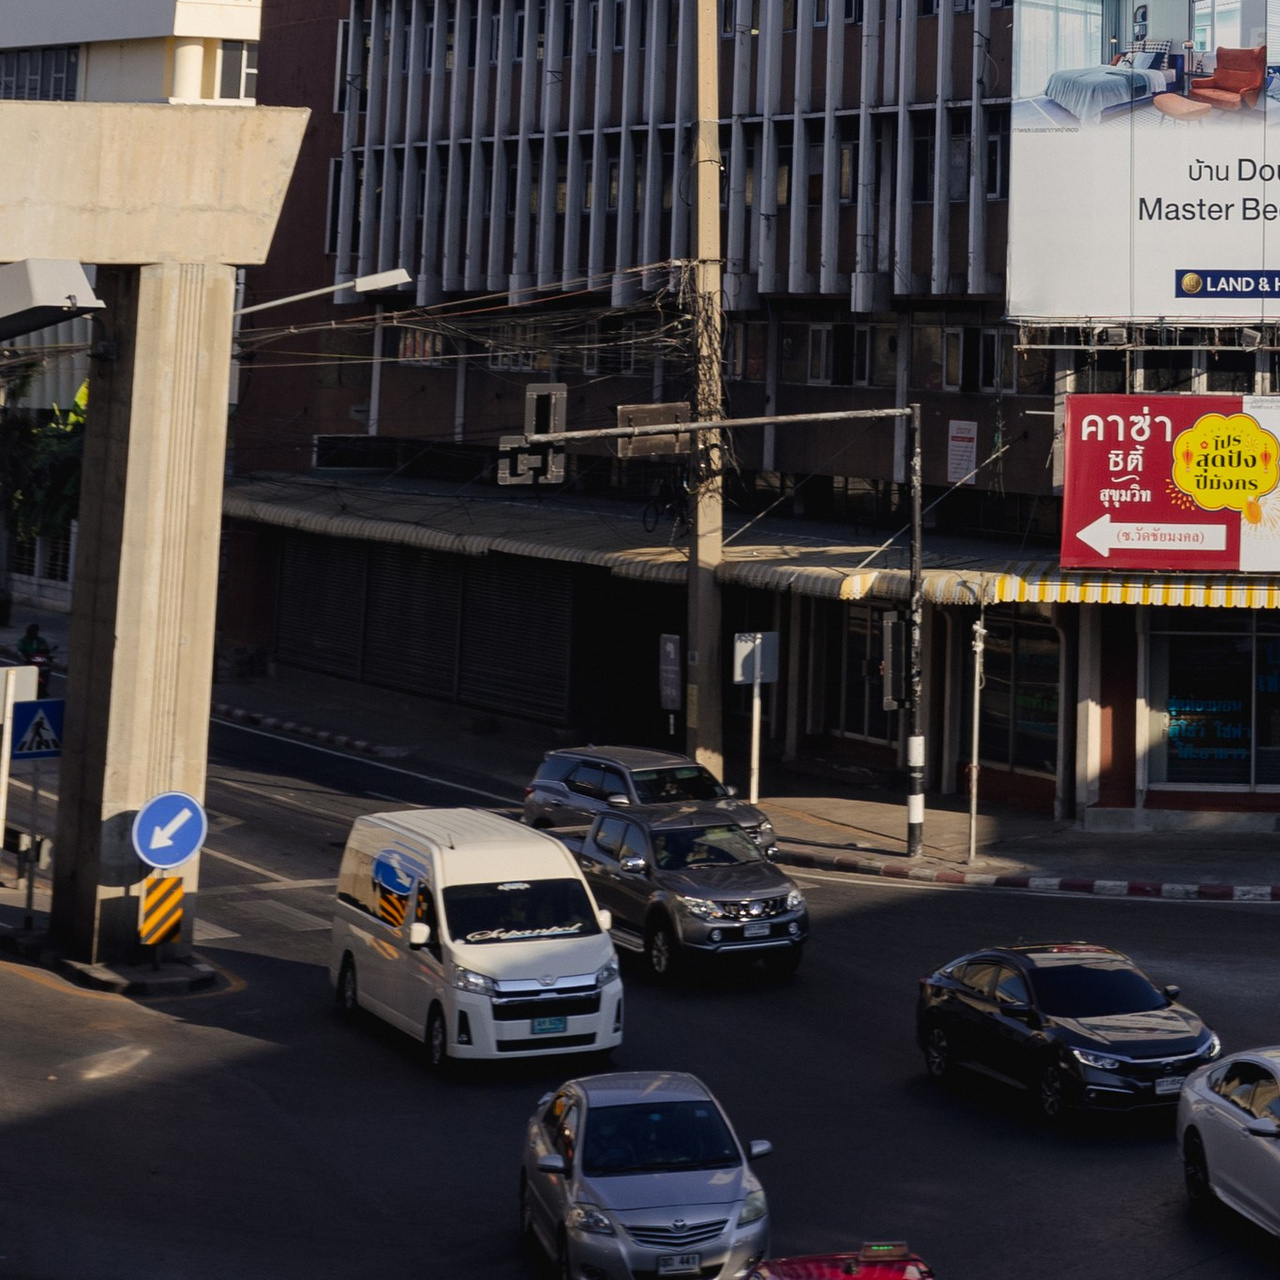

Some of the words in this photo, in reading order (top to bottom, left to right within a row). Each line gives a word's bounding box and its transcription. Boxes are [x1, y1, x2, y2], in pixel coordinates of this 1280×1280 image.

[1189, 157, 1230, 182] บ้าน
[1139, 197, 1234, 221] Master
[1207, 277, 1255, 291] LAND
[1258, 277, 1270, 291] &
[1081, 406, 1172, 442] คาซ่า
[1214, 435, 1241, 450] โปร
[1109, 445, 1145, 471] ซิตี้
[1195, 474, 1258, 490] ปีมังกร
[1100, 484, 1151, 508] สุขุมวิท
[1117, 527, 1204, 544] (ซ.วัดชัยมงคล)
